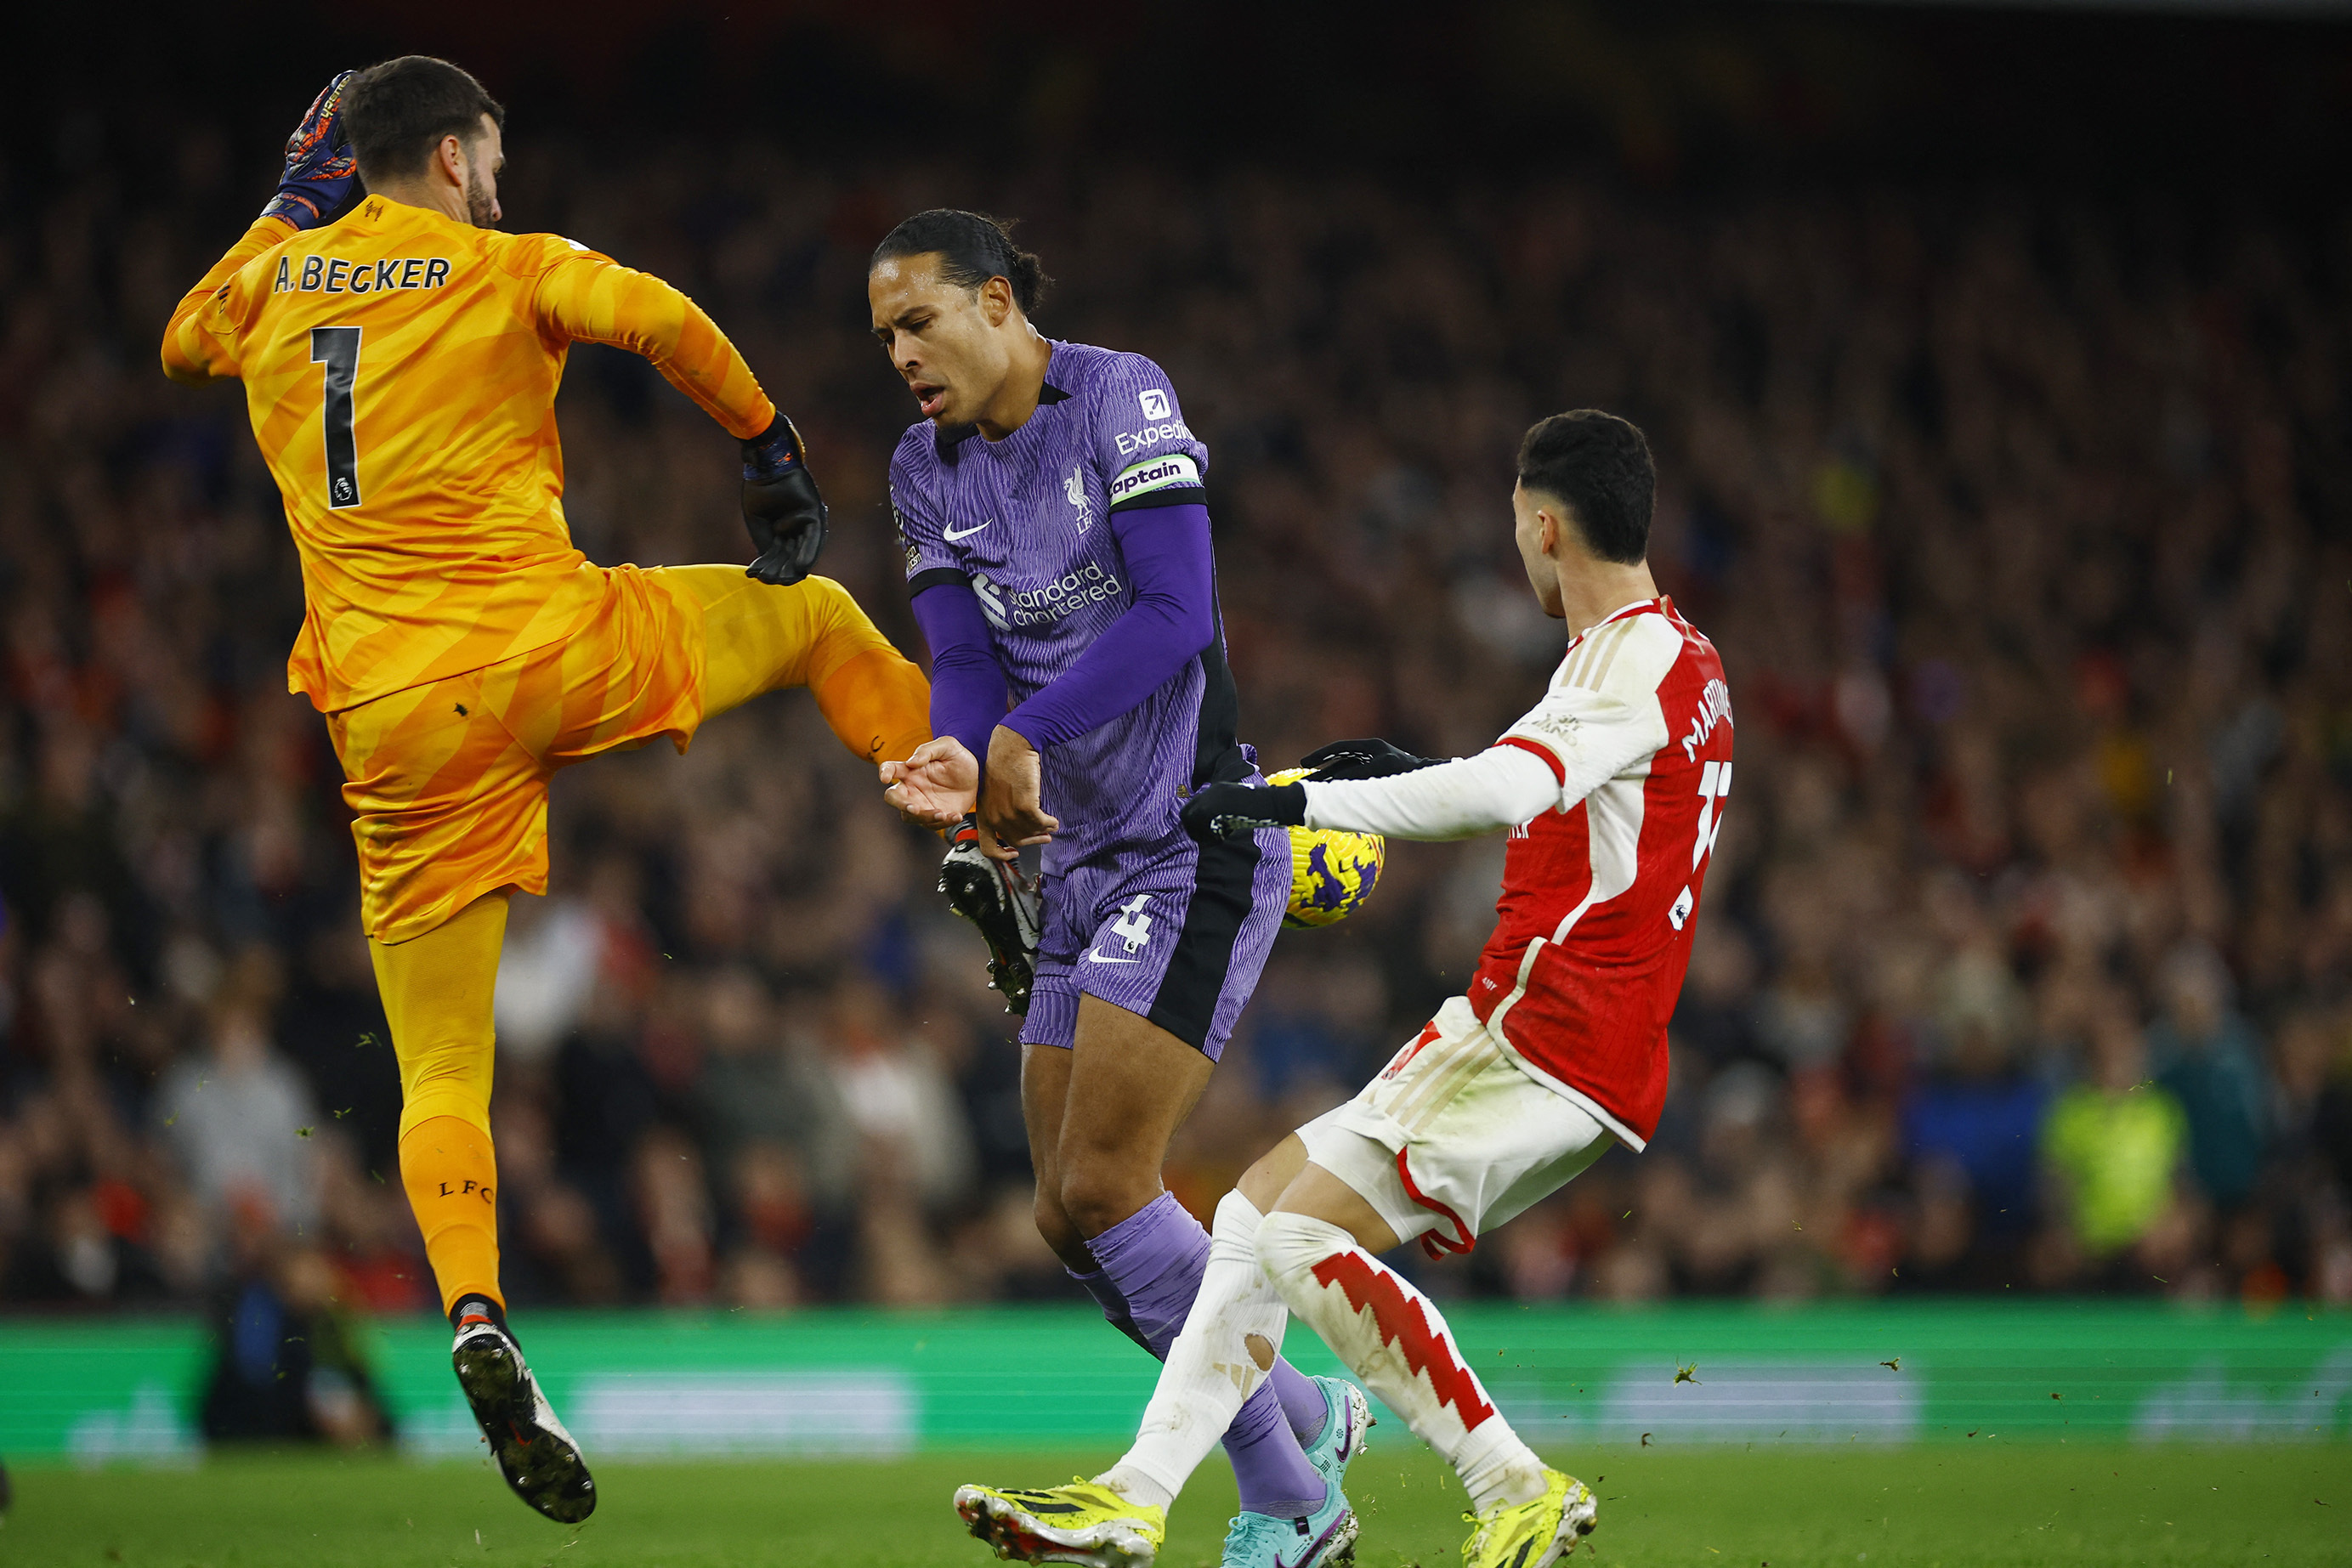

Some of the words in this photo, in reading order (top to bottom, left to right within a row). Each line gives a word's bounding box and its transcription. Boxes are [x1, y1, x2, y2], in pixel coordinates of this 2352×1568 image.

[274, 255, 451, 294] A.BECKER
[309, 325, 364, 510] 1
[1110, 461, 1182, 496] aptain
[1012, 574, 1123, 626] chartered
[1681, 678, 1734, 764] MARTINE
[1110, 894, 1153, 955] 4
[438, 1179, 495, 1206] LFC
